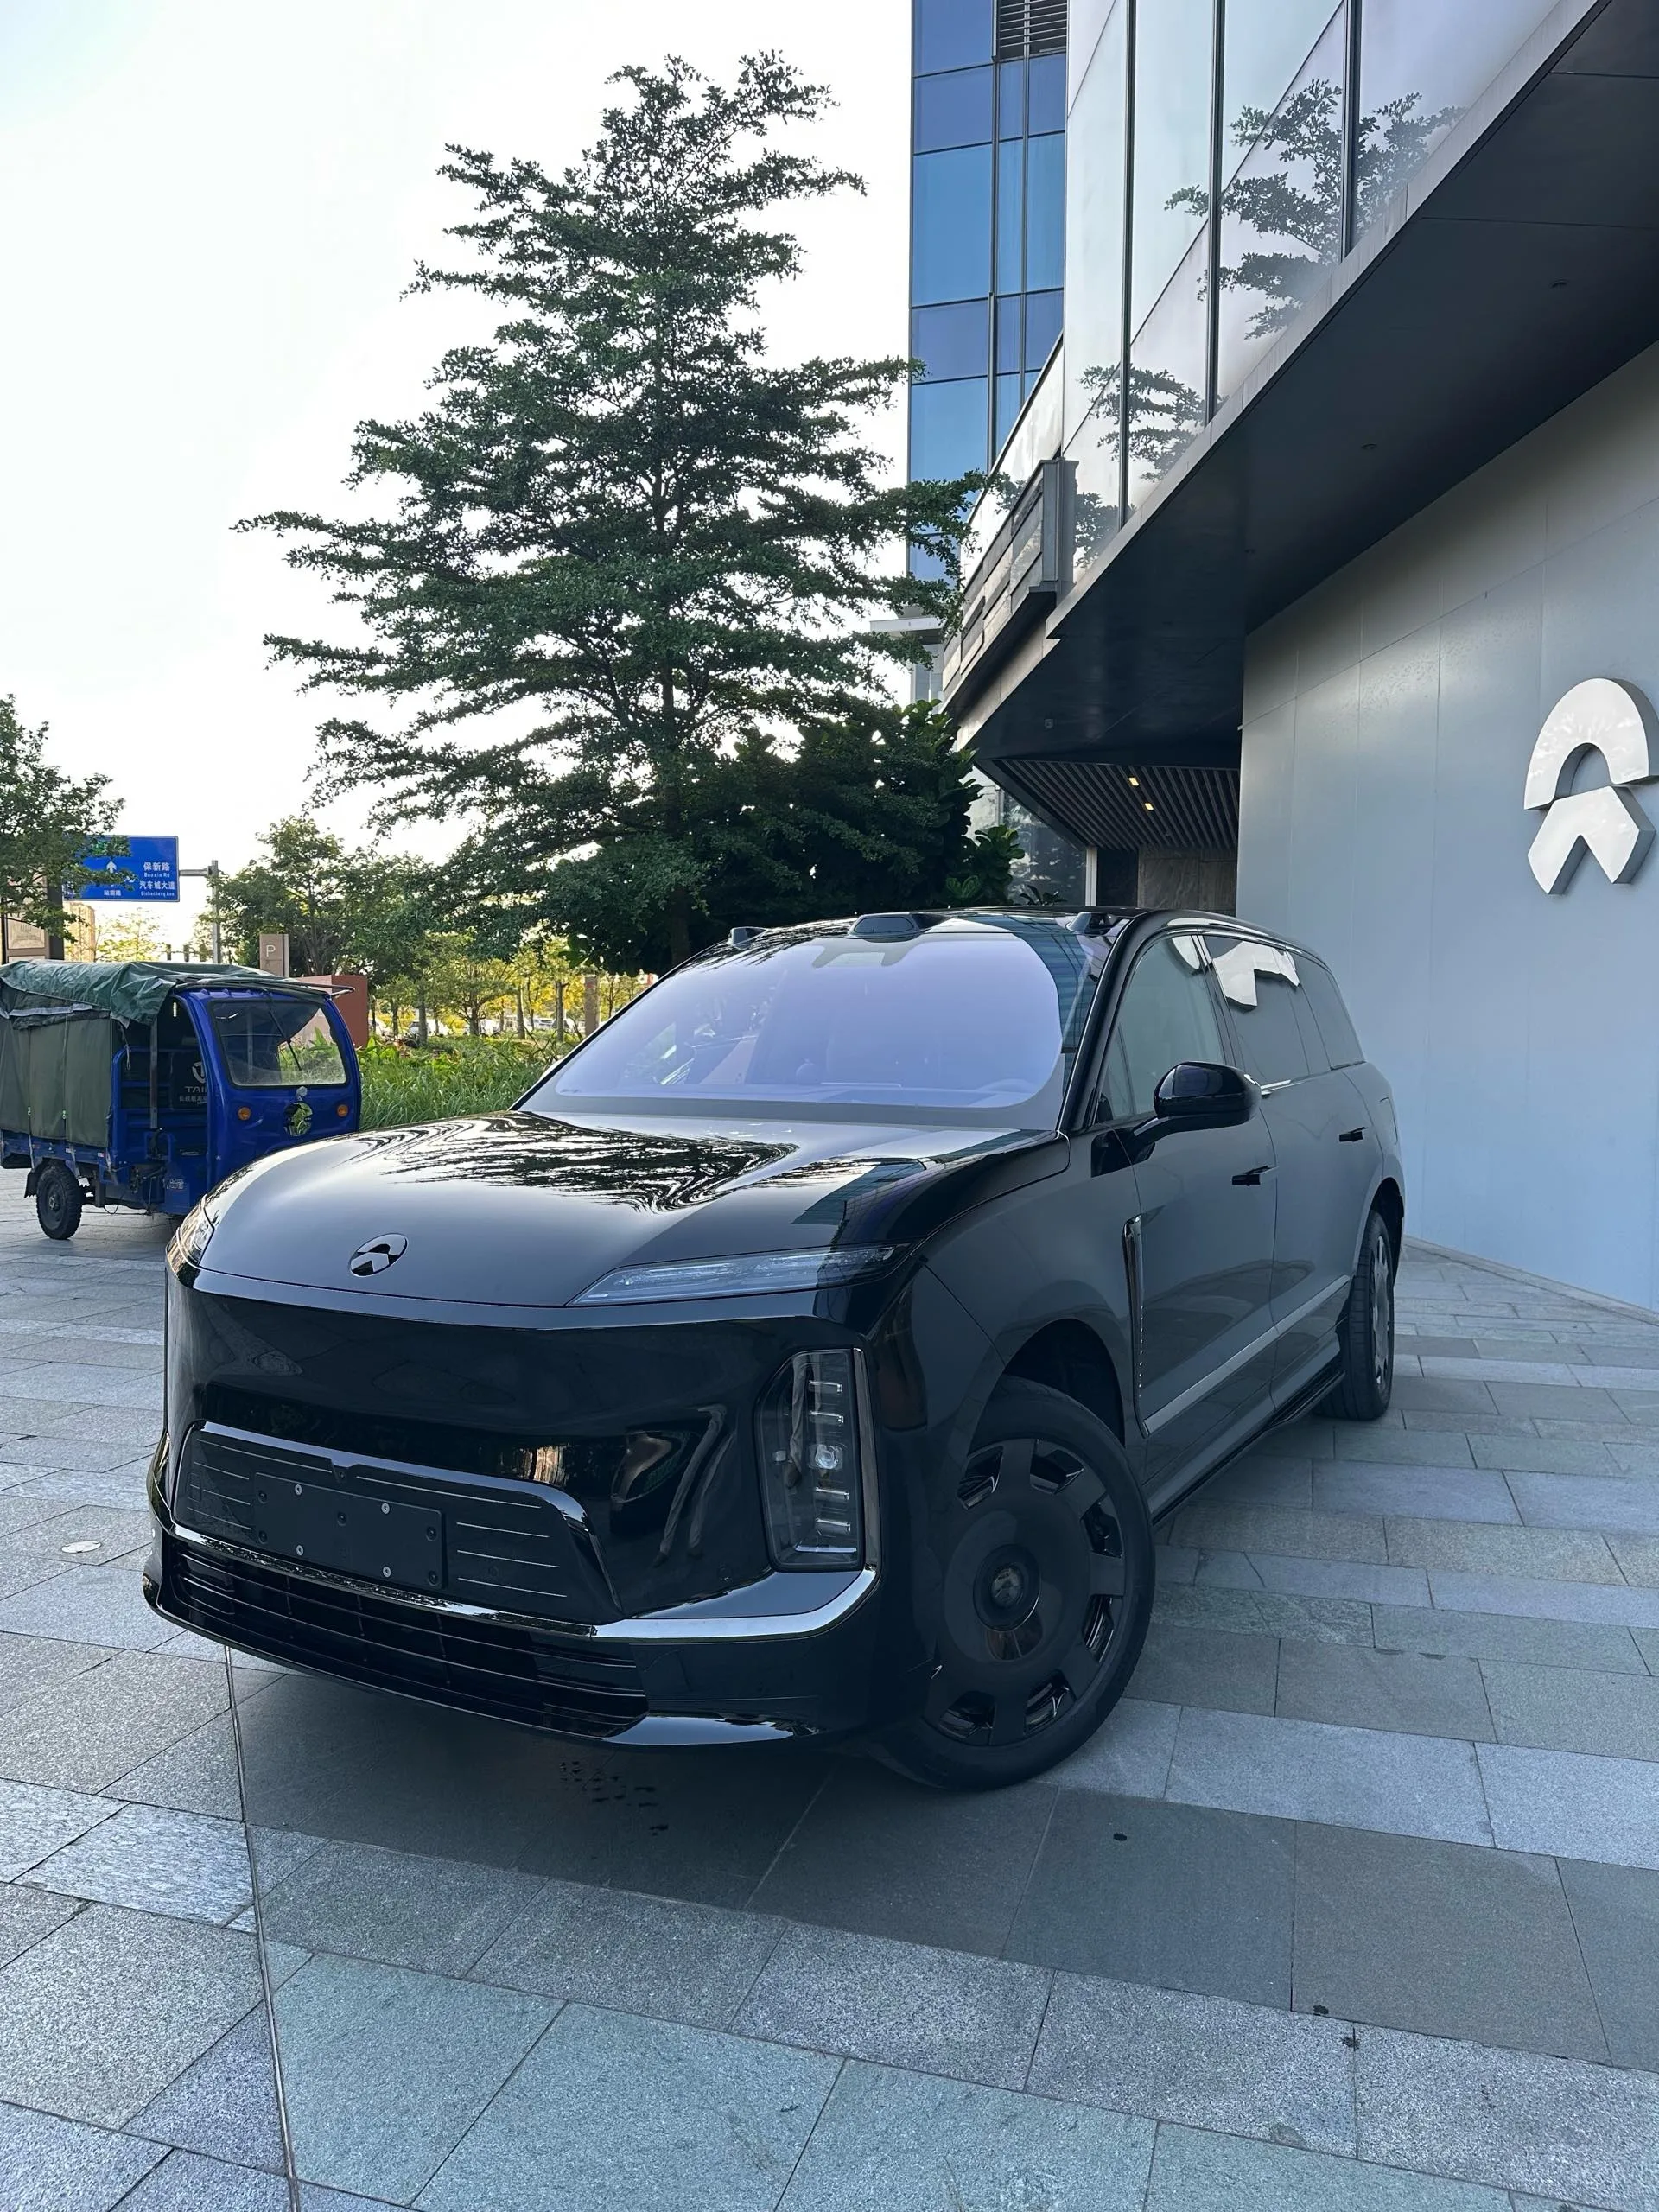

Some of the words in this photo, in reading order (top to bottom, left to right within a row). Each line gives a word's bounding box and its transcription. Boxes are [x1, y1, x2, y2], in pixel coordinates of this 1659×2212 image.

[139, 881, 175, 890] 汽车城大道
[266, 944, 276, 957] P
